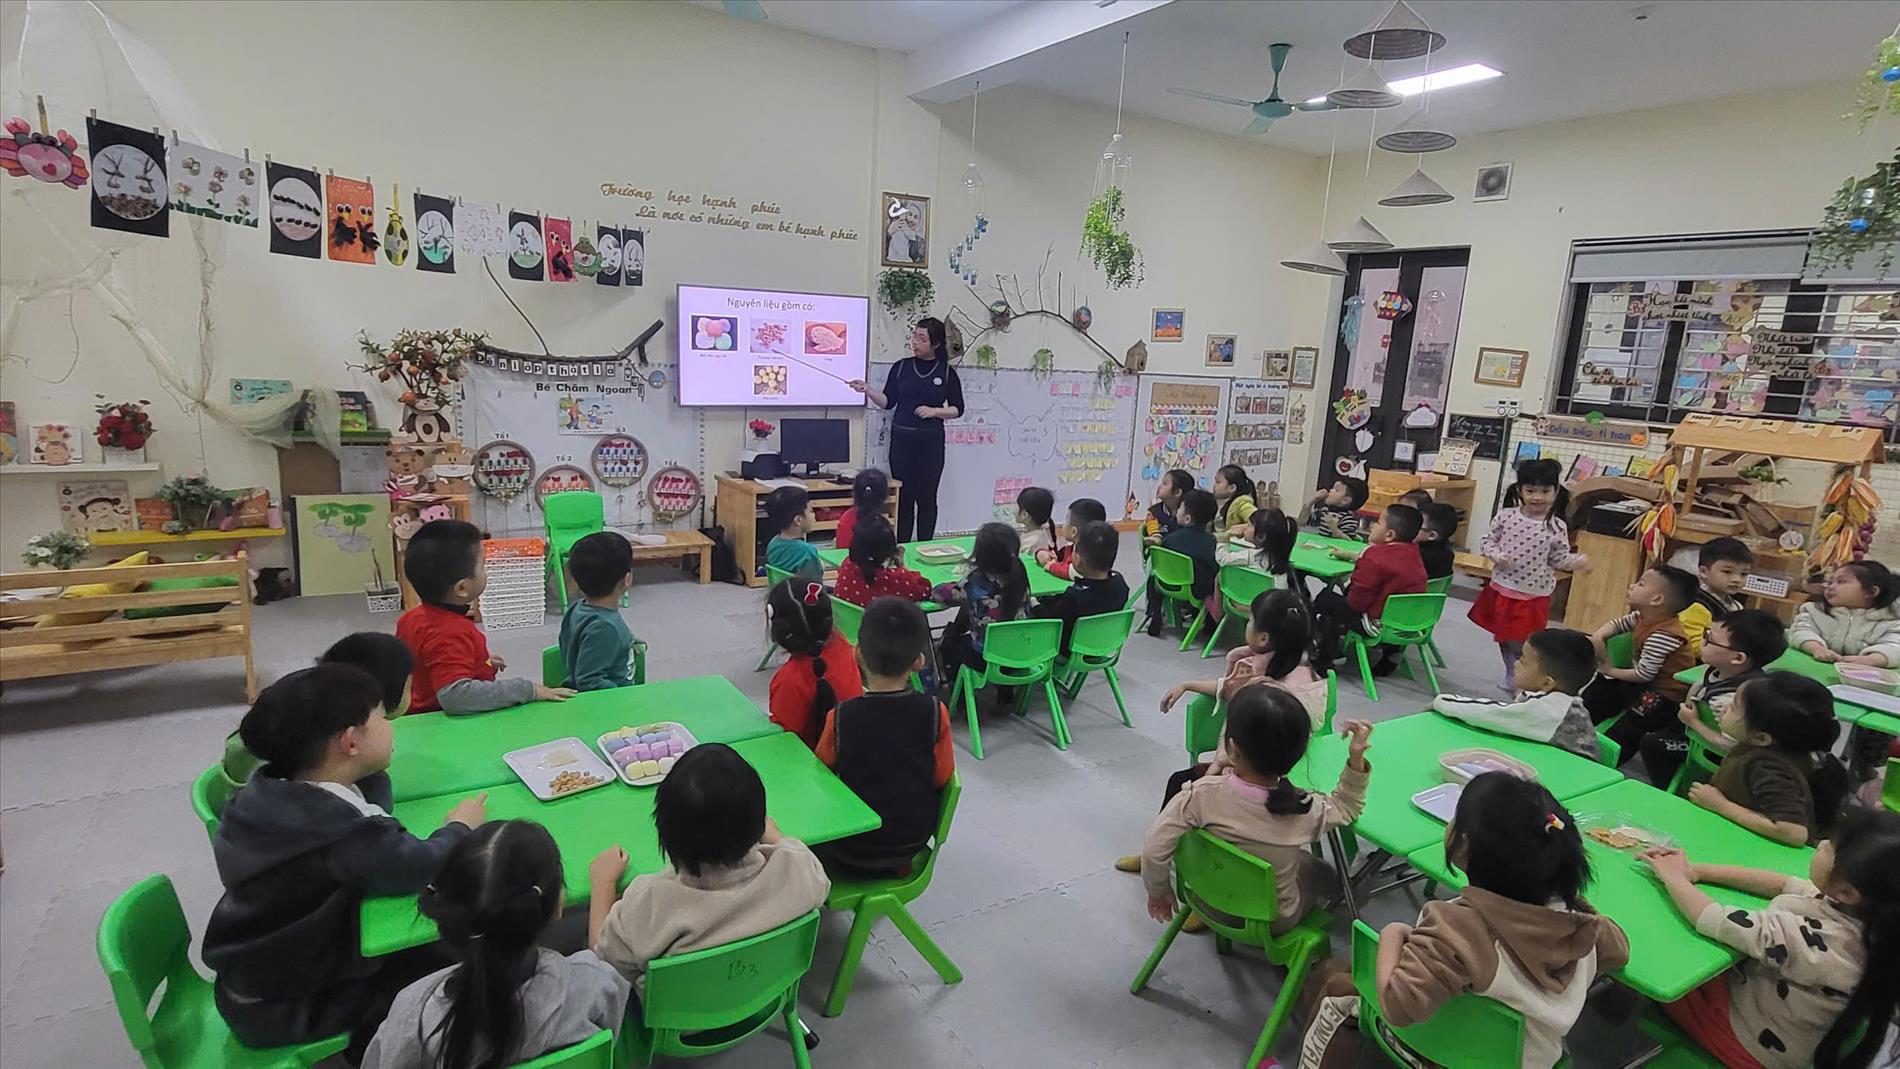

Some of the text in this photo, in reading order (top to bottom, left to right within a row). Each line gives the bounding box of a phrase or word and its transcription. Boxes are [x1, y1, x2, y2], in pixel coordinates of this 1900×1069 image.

[600, 183, 781, 214] Trường học hạnh phúc
[756, 221, 775, 231] em
[727, 297, 761, 309] Nguyên
[782, 300, 800, 311] gồm
[536, 382, 551, 392] Bé
[596, 384, 632, 396] Ngoan
